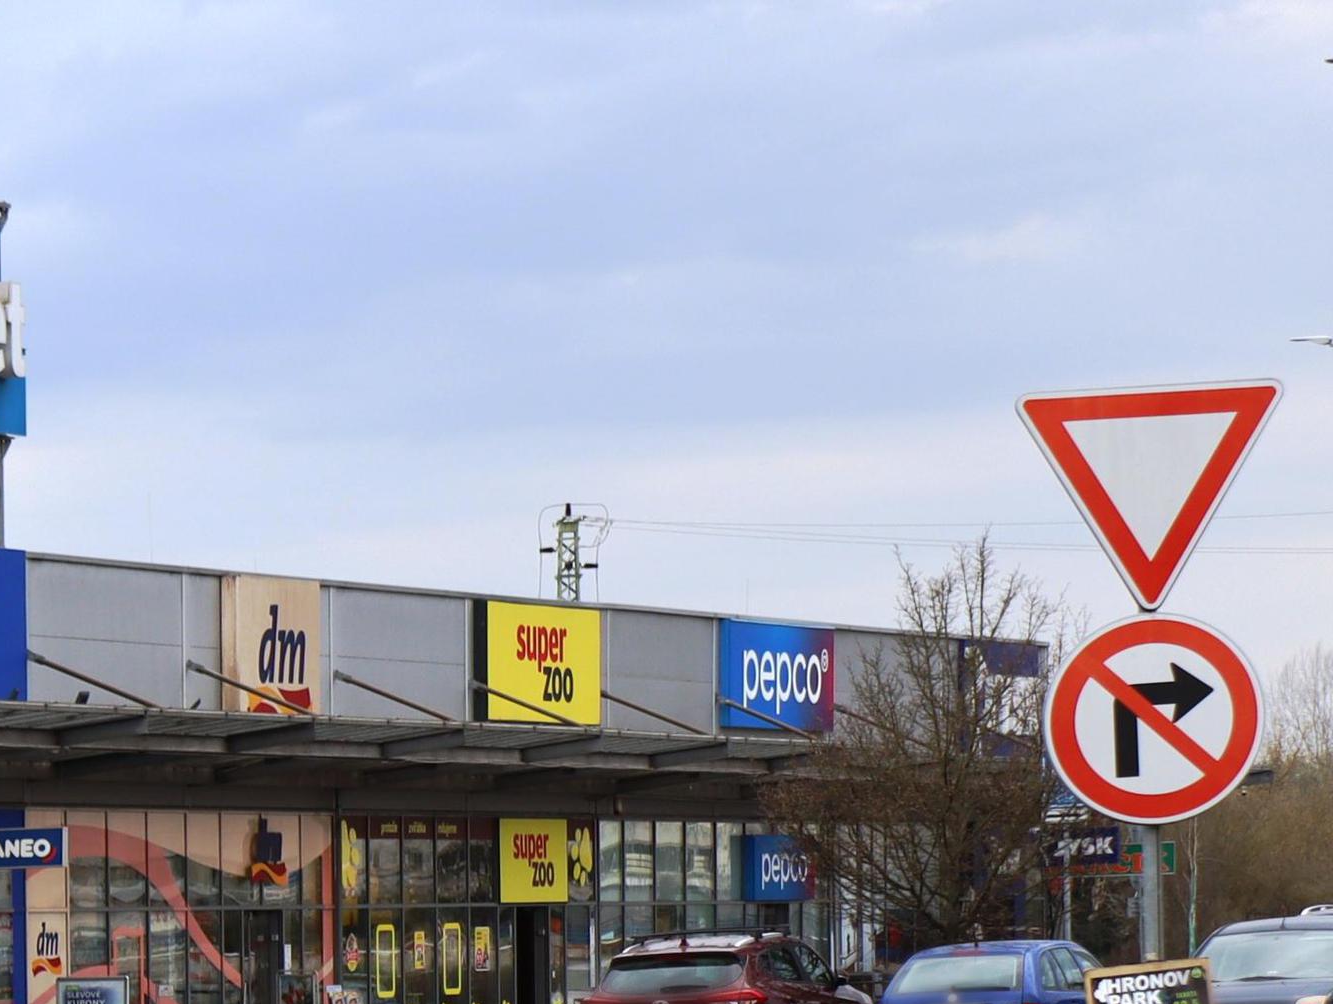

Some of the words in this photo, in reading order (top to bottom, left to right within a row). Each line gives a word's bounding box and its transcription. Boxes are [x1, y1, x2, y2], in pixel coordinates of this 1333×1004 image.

[258, 605, 306, 685] dm
[516, 624, 567, 671] super
[513, 832, 550, 867] super
[761, 852, 808, 890] pepco
[36, 922, 59, 956] dm
[1106, 968, 1191, 994] HRONOV
